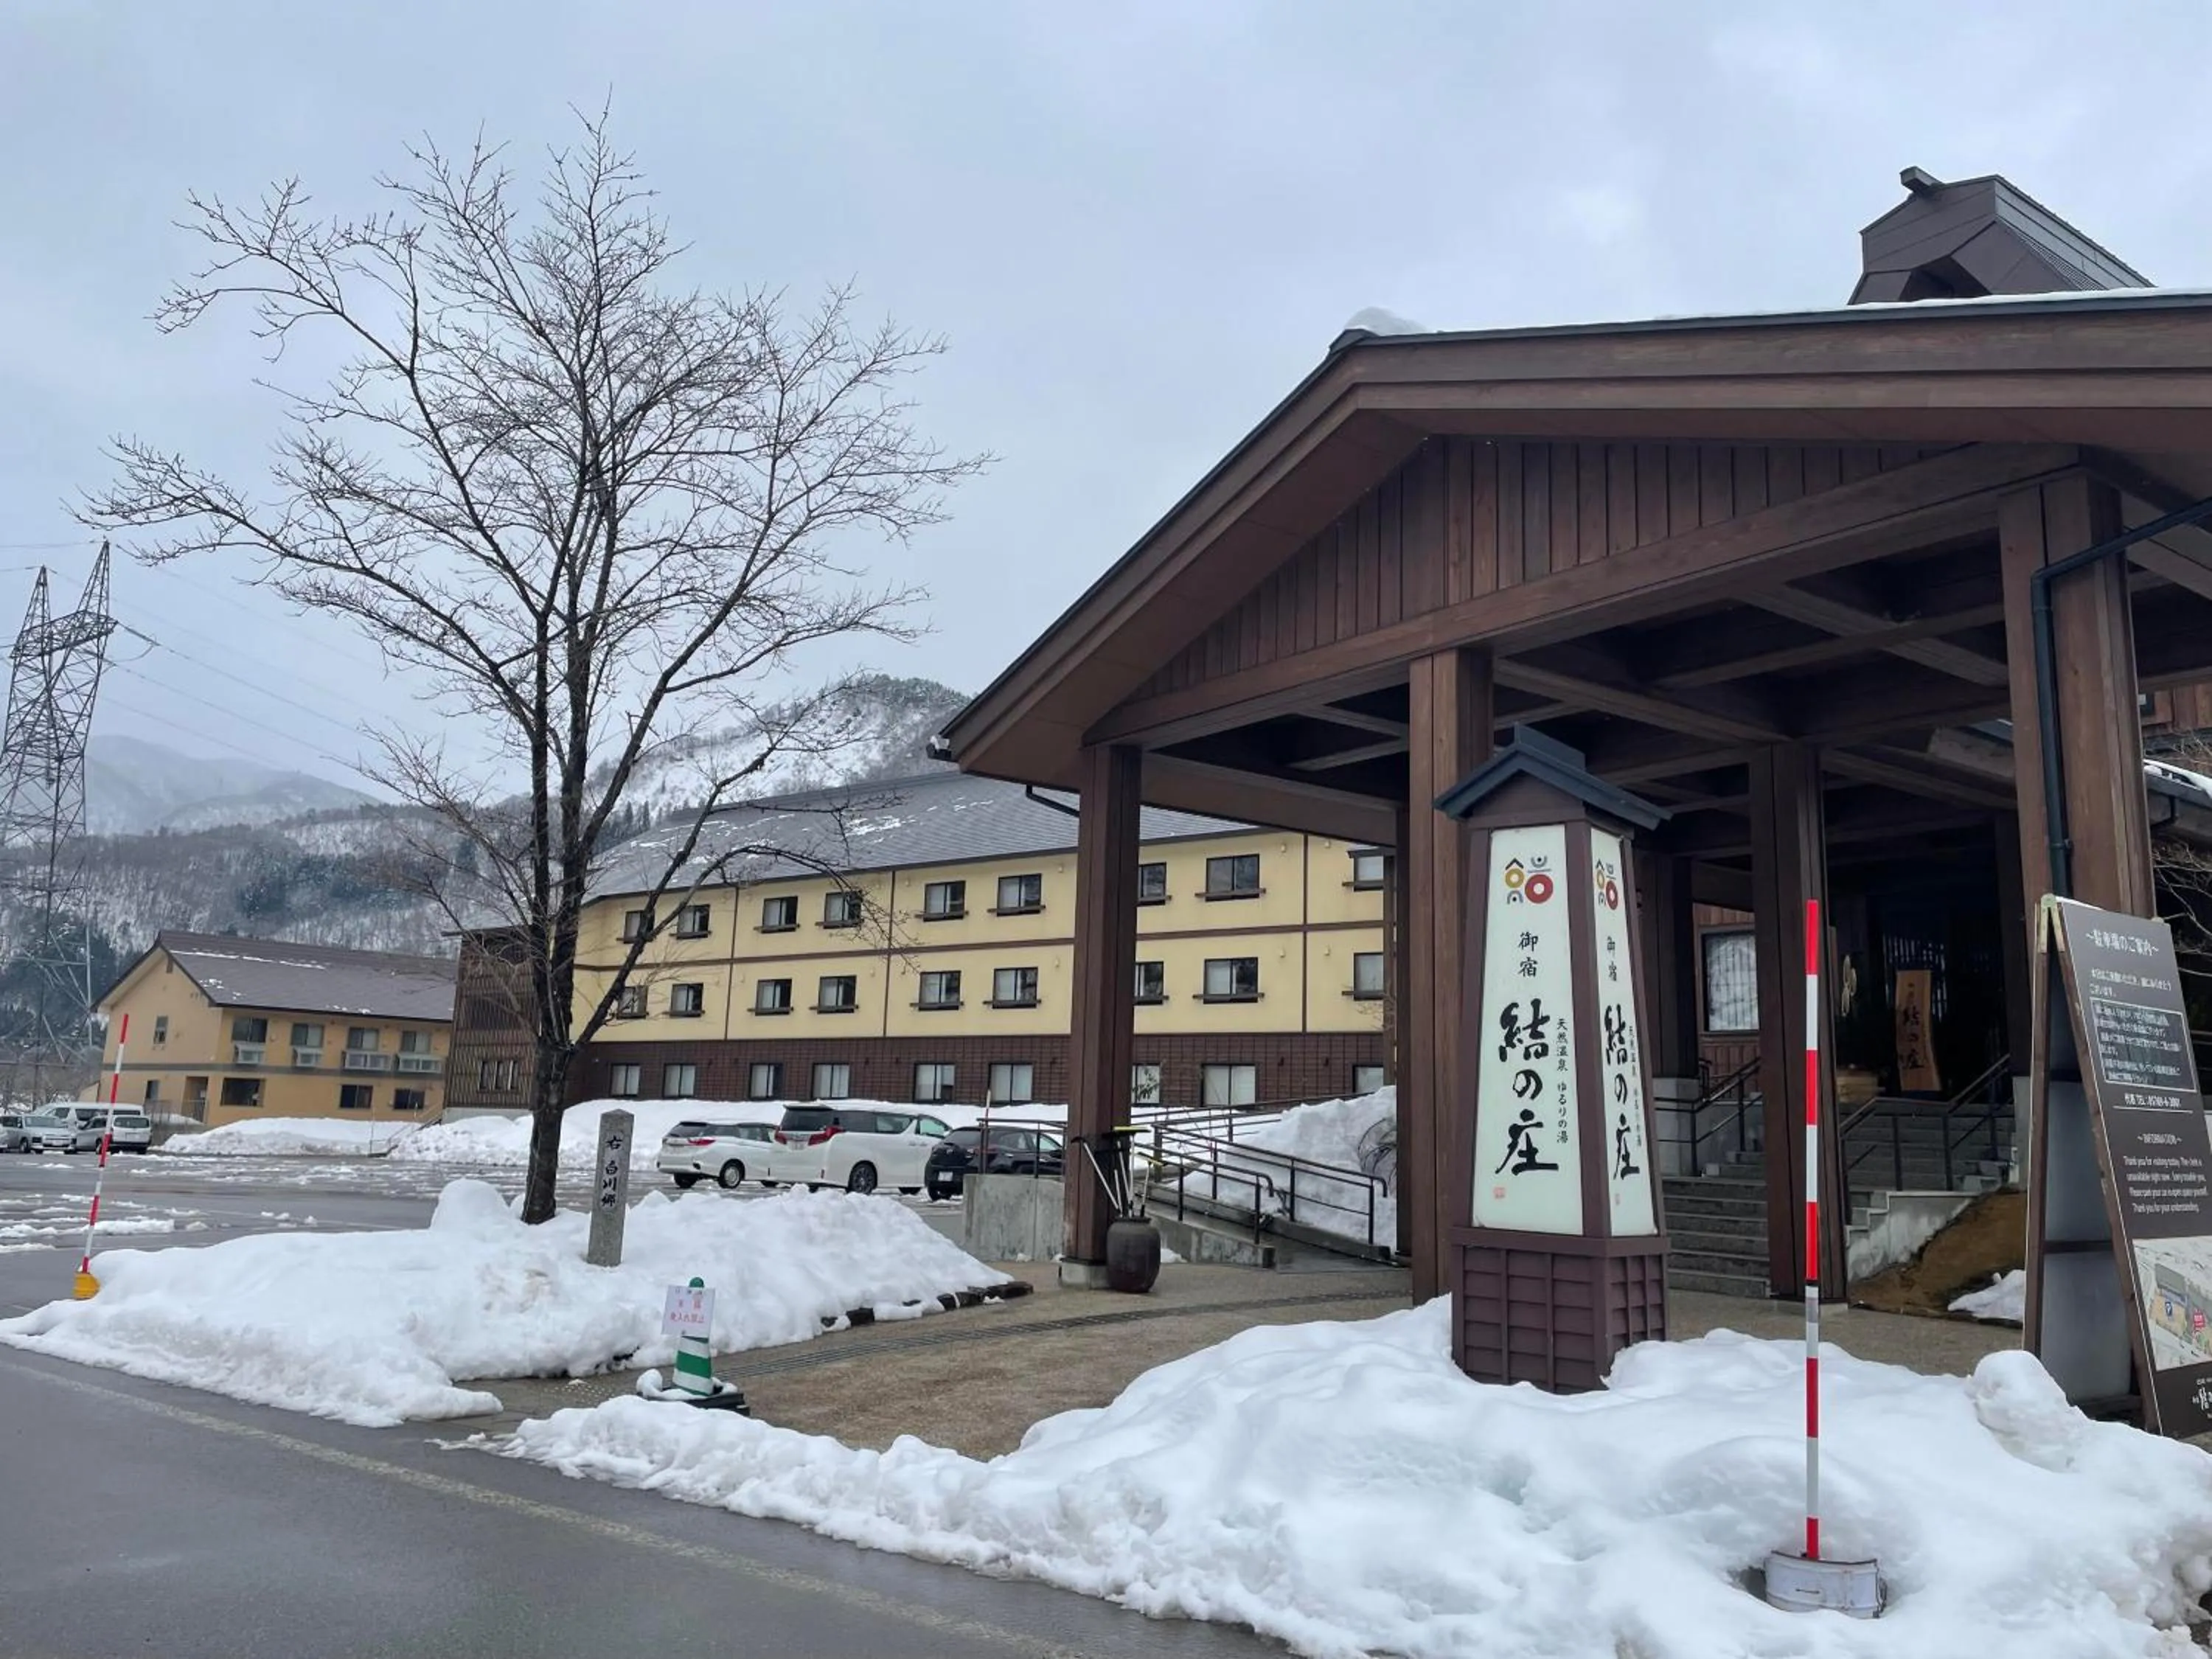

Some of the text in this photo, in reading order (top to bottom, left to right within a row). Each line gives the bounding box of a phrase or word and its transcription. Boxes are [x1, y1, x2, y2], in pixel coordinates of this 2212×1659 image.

[1517, 931, 1539, 977] 御宿
[1495, 998, 1559, 1176] 結の庄
[1557, 1018, 1568, 1144] 天然温泉 ゆるりの湯
[1604, 1003, 1640, 1180] 結の庄
[601, 1135, 623, 1208] 右 白川郷
